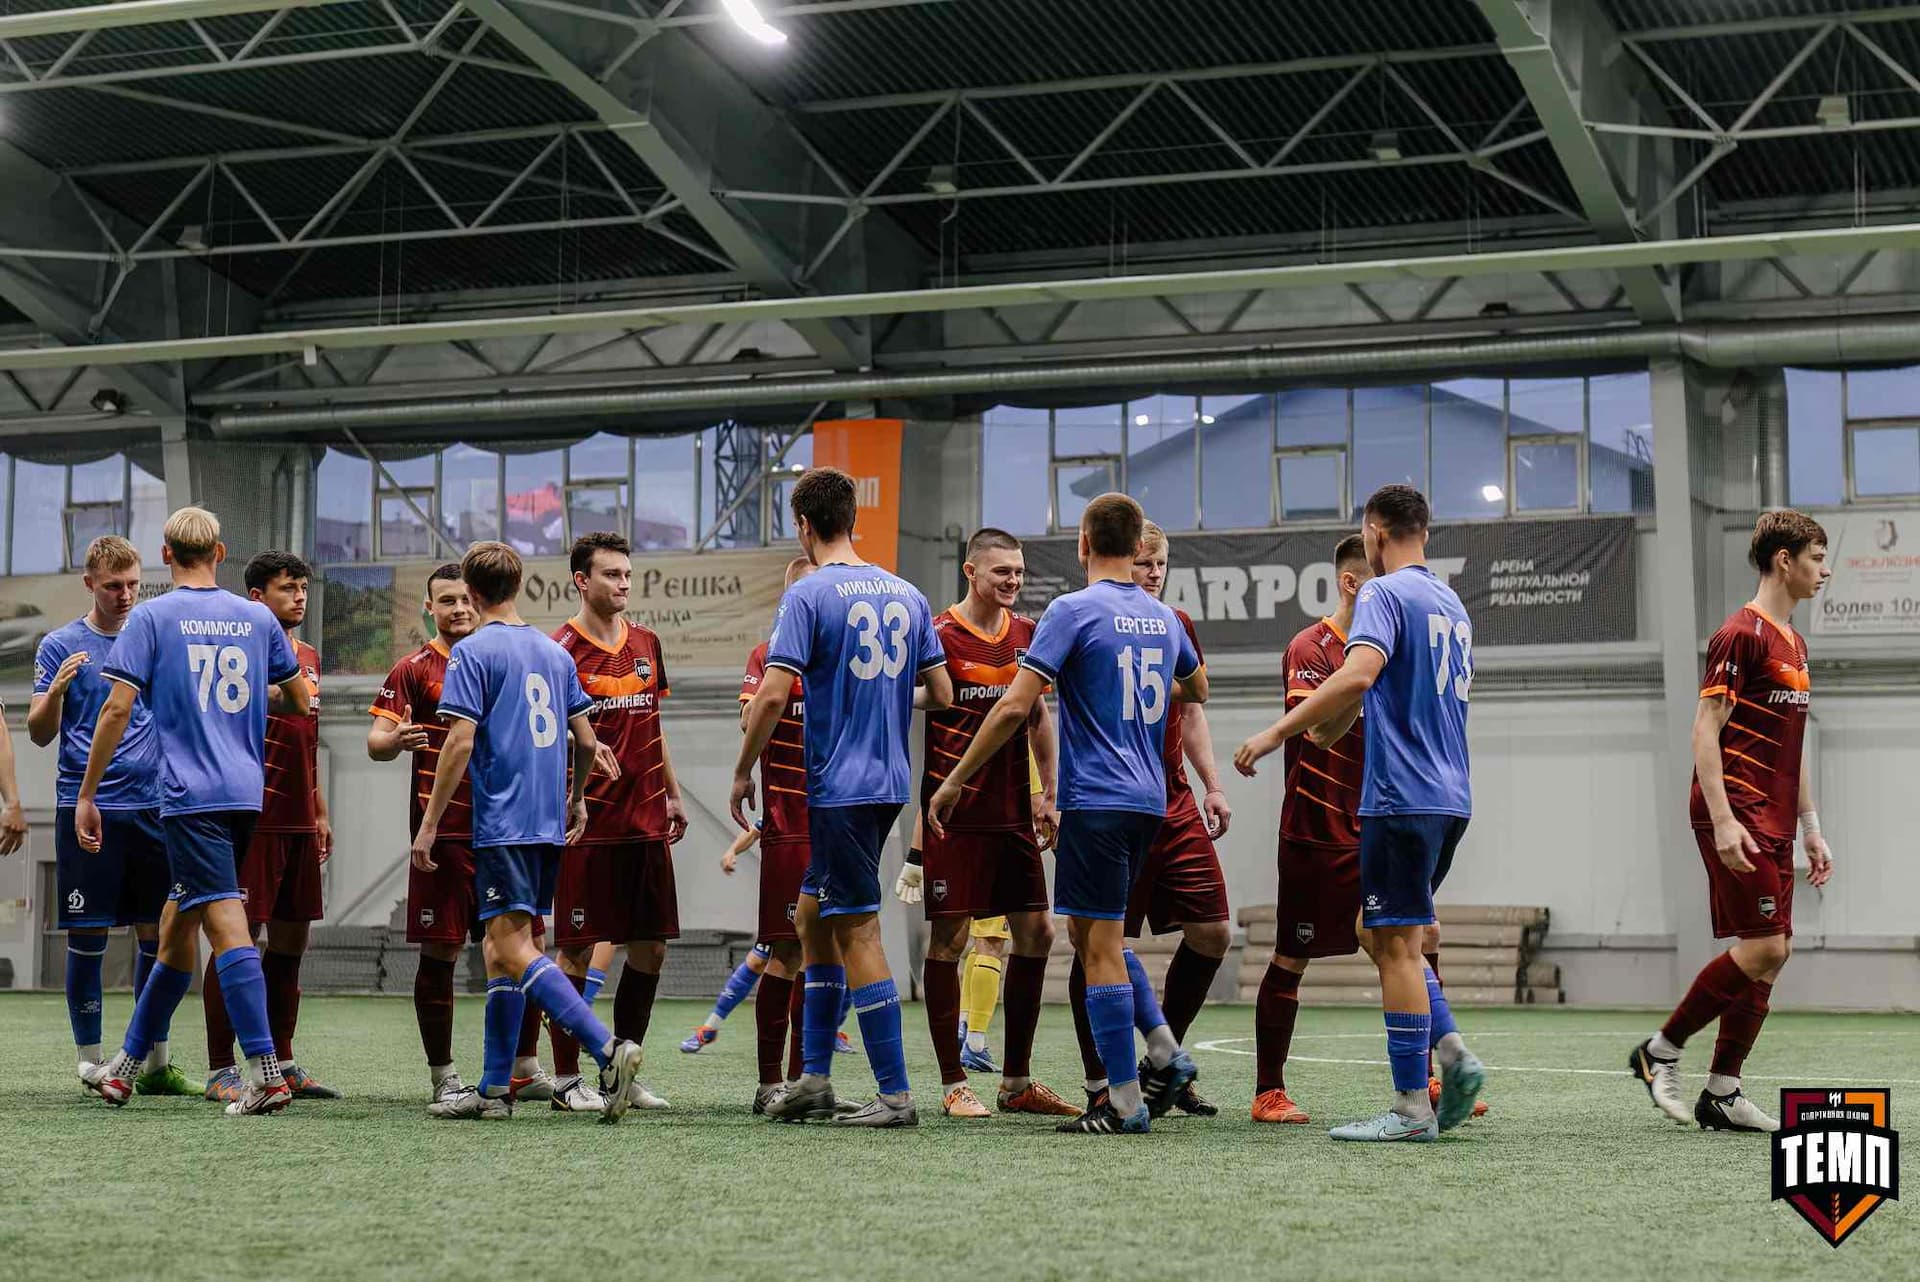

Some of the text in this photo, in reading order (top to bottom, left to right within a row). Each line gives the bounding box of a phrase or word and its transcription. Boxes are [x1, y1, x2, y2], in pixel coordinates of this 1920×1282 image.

[1490, 560, 1534, 574] АРЕНА
[642, 569, 743, 599] Решка
[834, 576, 909, 598] МИХАЙЛИН
[1490, 569, 1591, 591] ВИРТУАЛЬНОЙ
[1490, 589, 1583, 607] РЕАЛЬНОСТИ
[1823, 599, 1884, 615] более
[180, 619, 252, 637] КОММУСАР
[1113, 615, 1167, 635] СЕРГЕЕВ
[847, 600, 911, 680] 33
[1427, 613, 1475, 702] 73
[187, 644, 250, 714] 78
[1117, 645, 1166, 725] 15
[525, 672, 558, 748] 8
